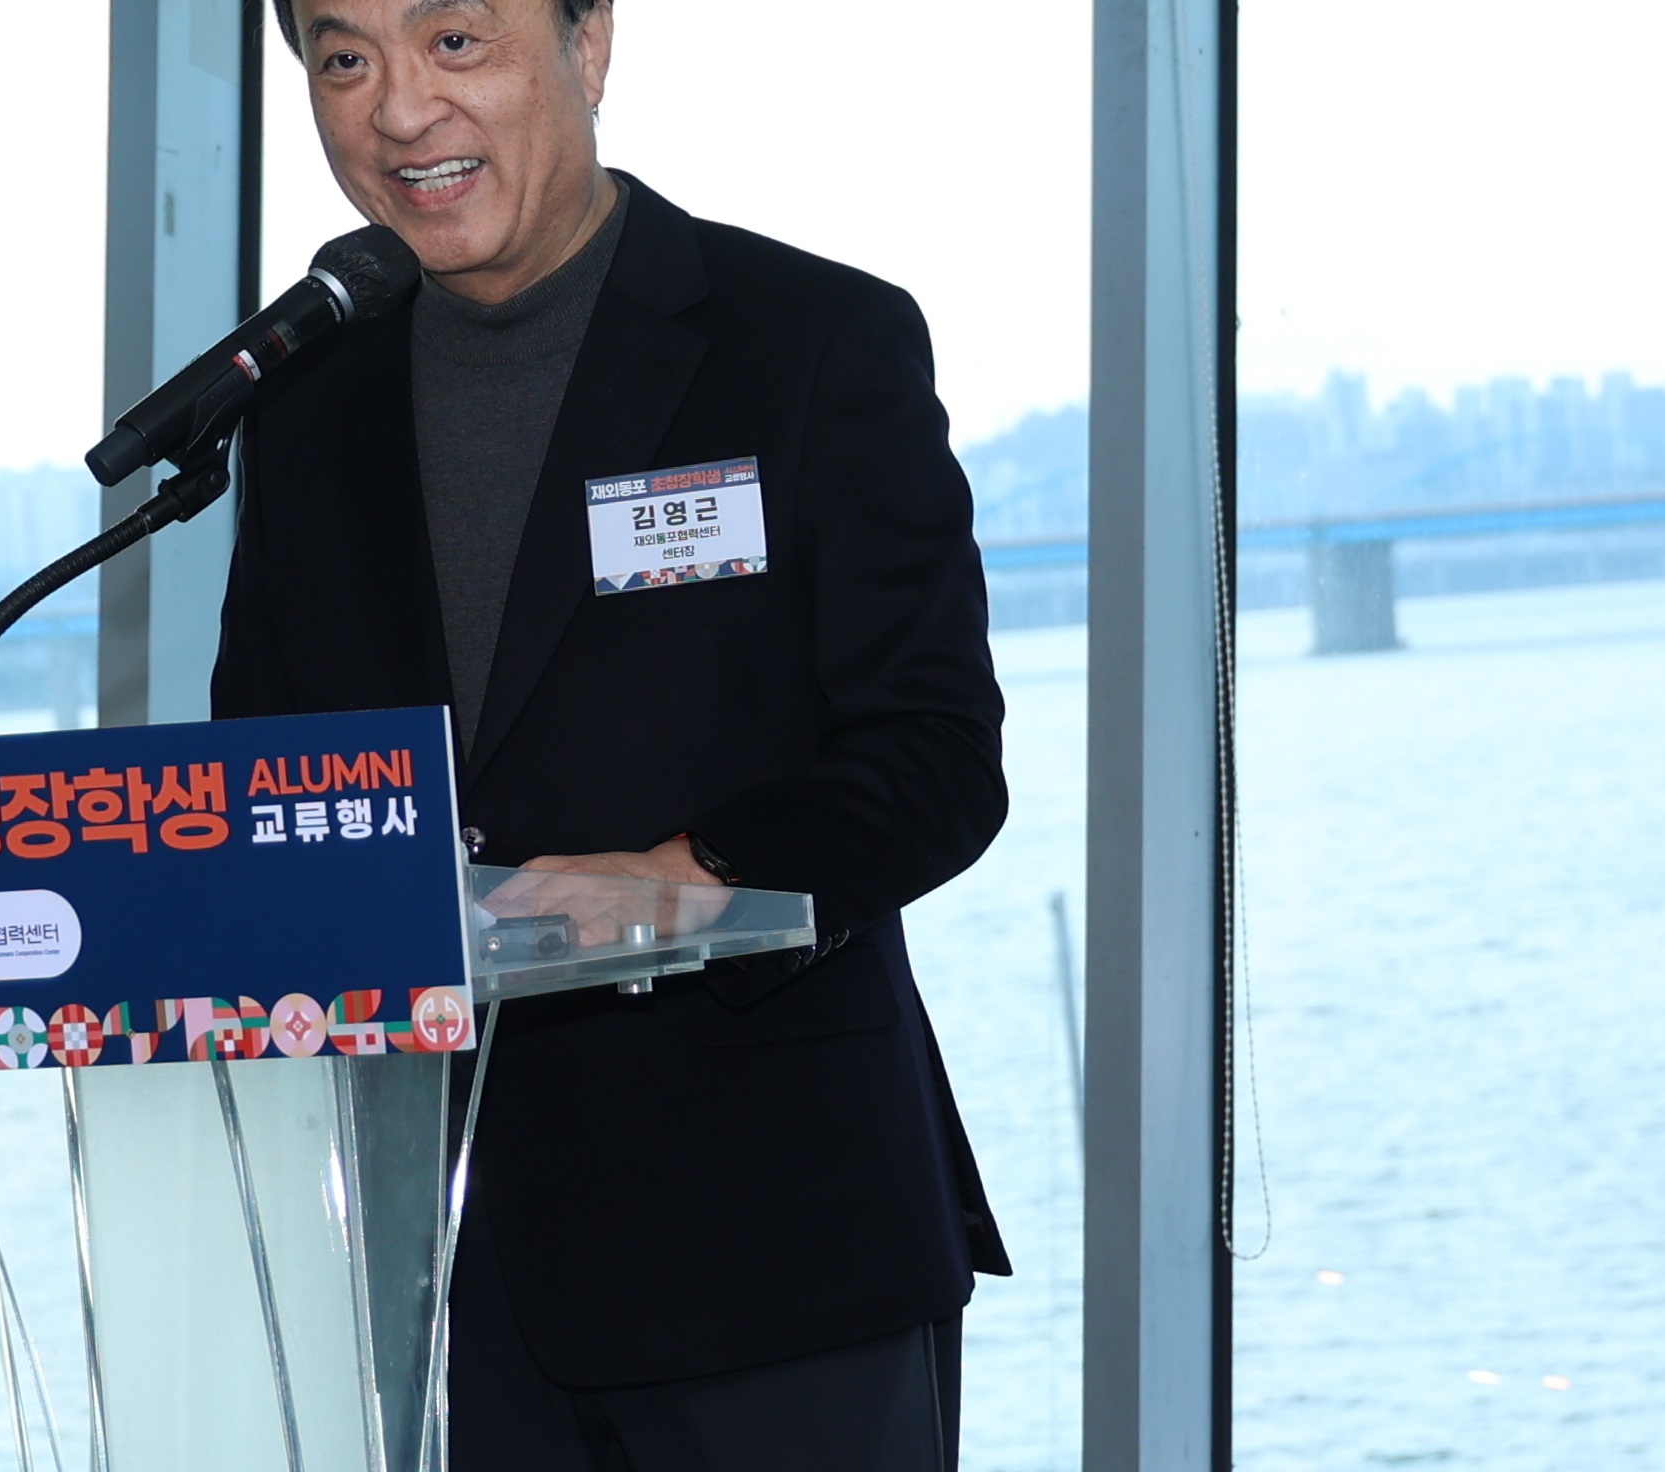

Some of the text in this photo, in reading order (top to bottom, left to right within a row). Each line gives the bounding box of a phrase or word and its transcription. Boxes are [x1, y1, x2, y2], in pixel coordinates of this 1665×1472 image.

[590, 478, 648, 500] 재외동포
[633, 525, 721, 547] 재외동포협력센터
[662, 545, 695, 560] 센터장
[248, 749, 414, 797] ALUMNI
[249, 794, 418, 843] 교류행사
